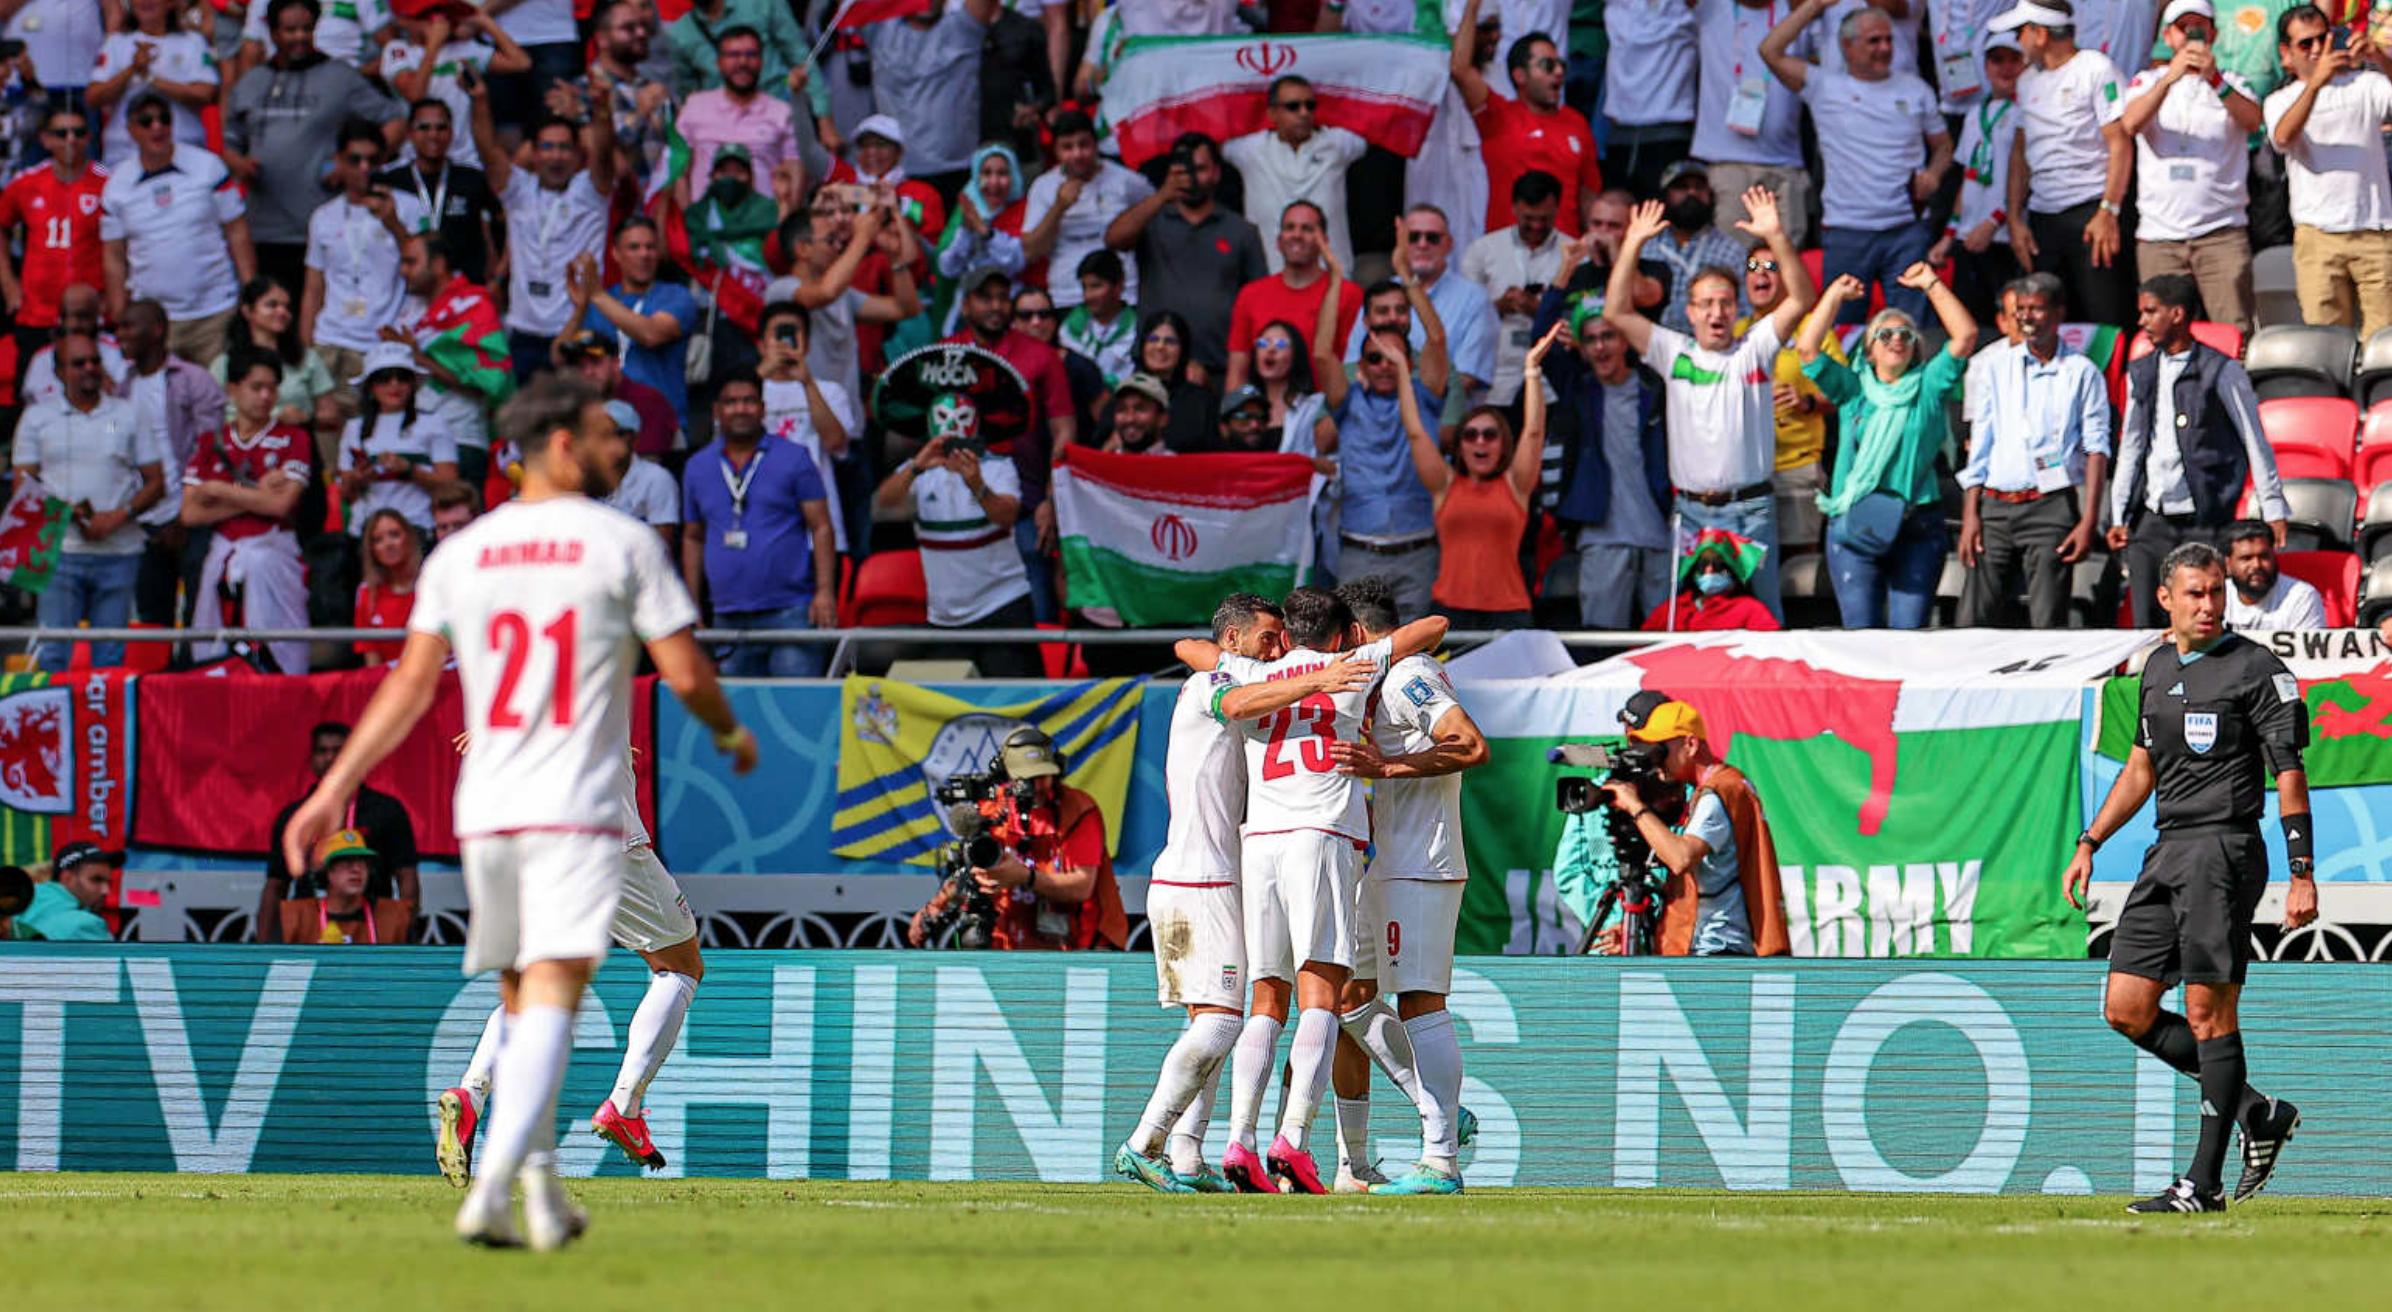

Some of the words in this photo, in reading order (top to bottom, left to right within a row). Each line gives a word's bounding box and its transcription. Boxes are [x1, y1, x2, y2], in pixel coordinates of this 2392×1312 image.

[46, 216, 71, 248] 11
[487, 607, 575, 728] 21
[1257, 691, 1338, 782] 23
[2188, 716, 2213, 726] FIFA
[87, 724, 117, 838] amber
[1386, 921, 1400, 957] 9
[0, 956, 317, 1173] TV
